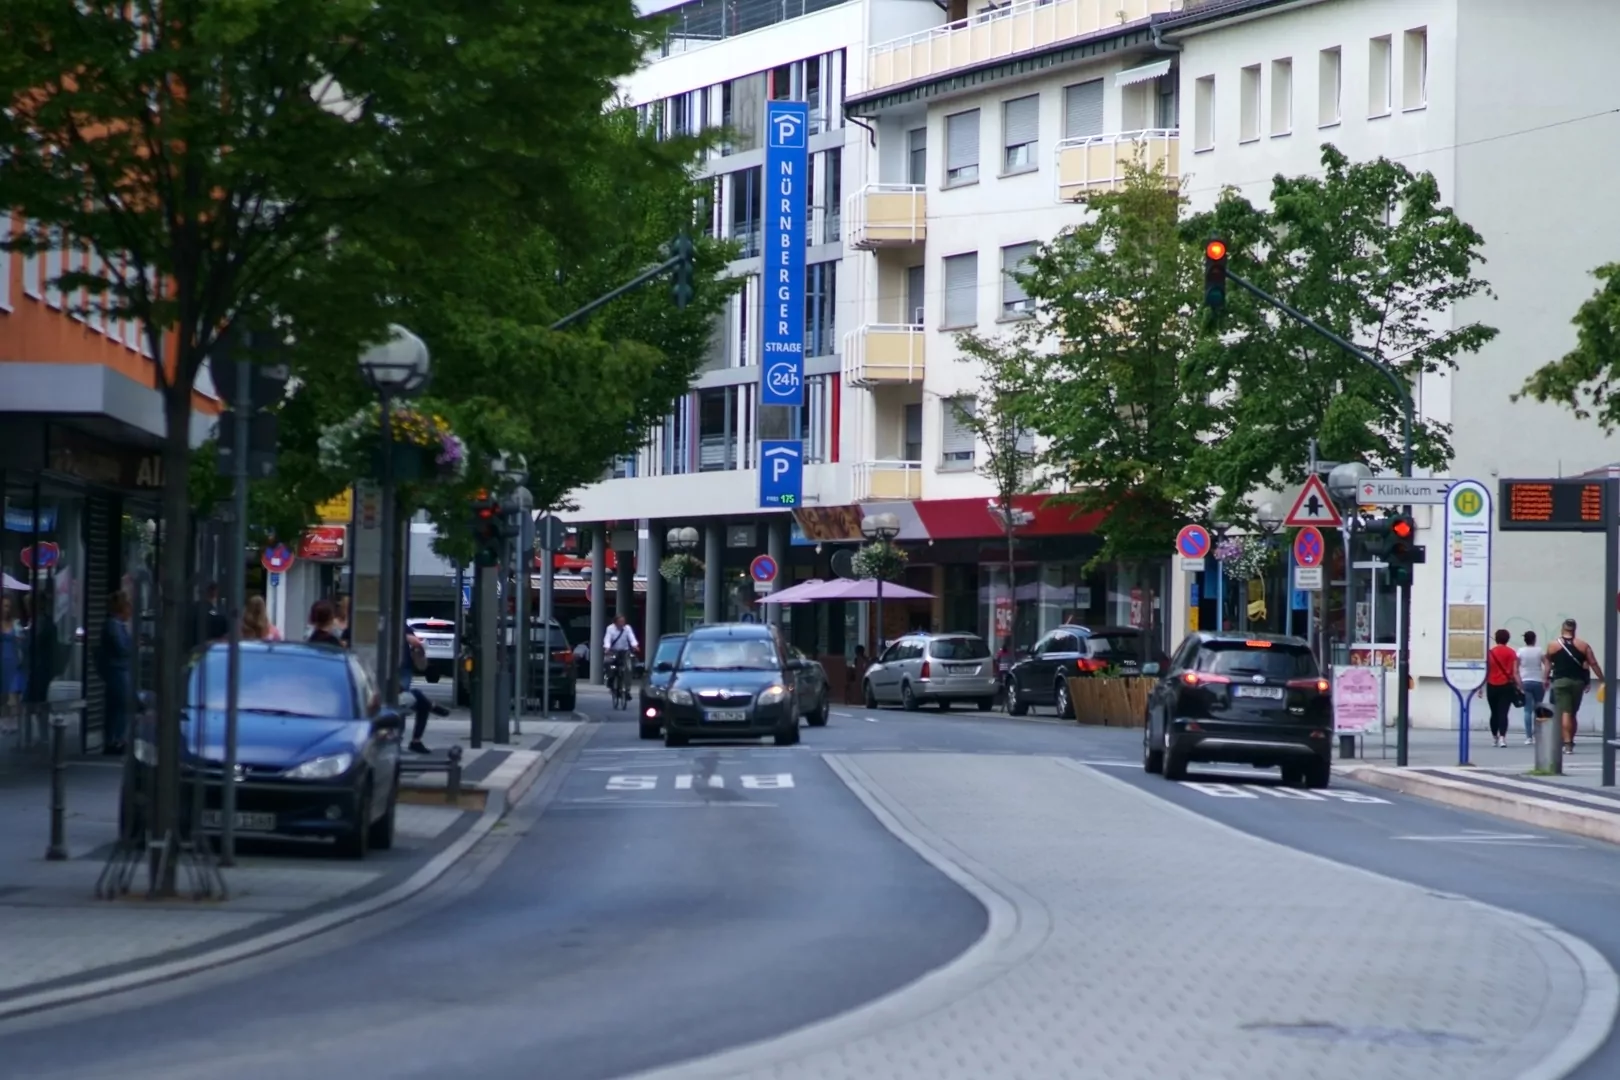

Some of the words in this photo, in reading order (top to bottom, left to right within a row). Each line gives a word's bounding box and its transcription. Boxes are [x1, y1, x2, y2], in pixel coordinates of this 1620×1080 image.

[779, 122, 795, 144] P
[778, 160, 793, 336] NÜRNBERGER
[772, 372, 800, 386] 24h
[773, 458, 789, 482] P
[1377, 484, 1431, 496] Klinikum
[780, 495, 795, 503] 175
[1462, 494, 1476, 511] H
